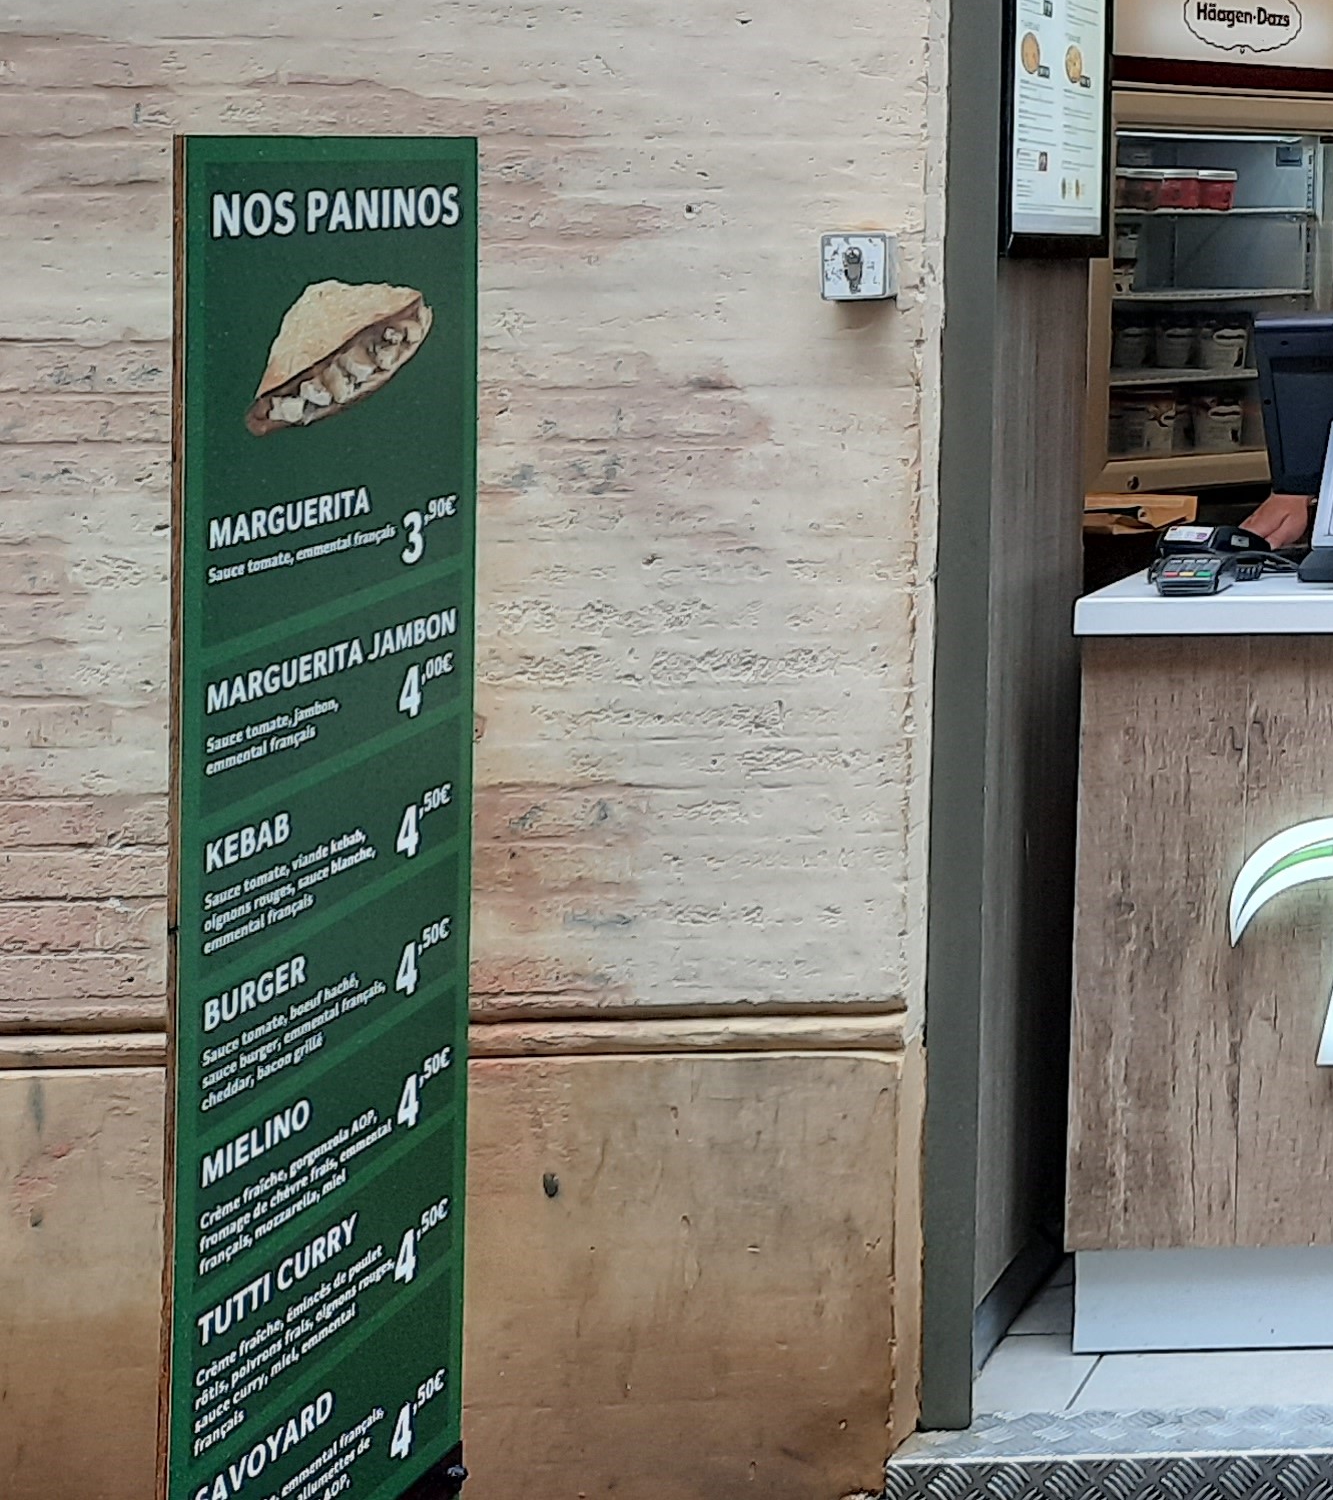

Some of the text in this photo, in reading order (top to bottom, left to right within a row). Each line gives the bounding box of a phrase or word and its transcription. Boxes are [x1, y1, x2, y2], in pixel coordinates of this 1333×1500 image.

[213, 186, 460, 237] NOS PANINOS
[209, 487, 370, 549] MARGUERITA
[208, 524, 396, 583] Sauce tomate, emmental français
[207, 608, 457, 714] MARGUERITA JAMBON
[206, 725, 316, 775] emmental français
[207, 698, 340, 753] Sauce tomate, jambon,
[204, 828, 366, 910] Sauce tomate, viande kebab,
[205, 813, 290, 873] KEBAB
[204, 845, 376, 932] oignons rouges, sauce blanche,
[204, 893, 314, 954] emmental français
[204, 956, 306, 1032] BURGER
[202, 1037, 239, 1067] Sauce
[242, 1012, 288, 1046] tomate,
[202, 1061, 237, 1089] sauce
[239, 1040, 281, 1068] burger,
[201, 1074, 255, 1111] cheddar,
[201, 1100, 310, 1188] MIELINO
[322, 1168, 347, 1195] miel
[199, 1211, 251, 1252] fromage
[253, 1201, 268, 1219] de
[200, 1195, 240, 1229] Crème
[198, 1212, 357, 1346] TUTTI CURRY
[196, 1349, 236, 1386] Crème
[333, 1271, 347, 1288] de
[357, 1436, 372, 1456] de
